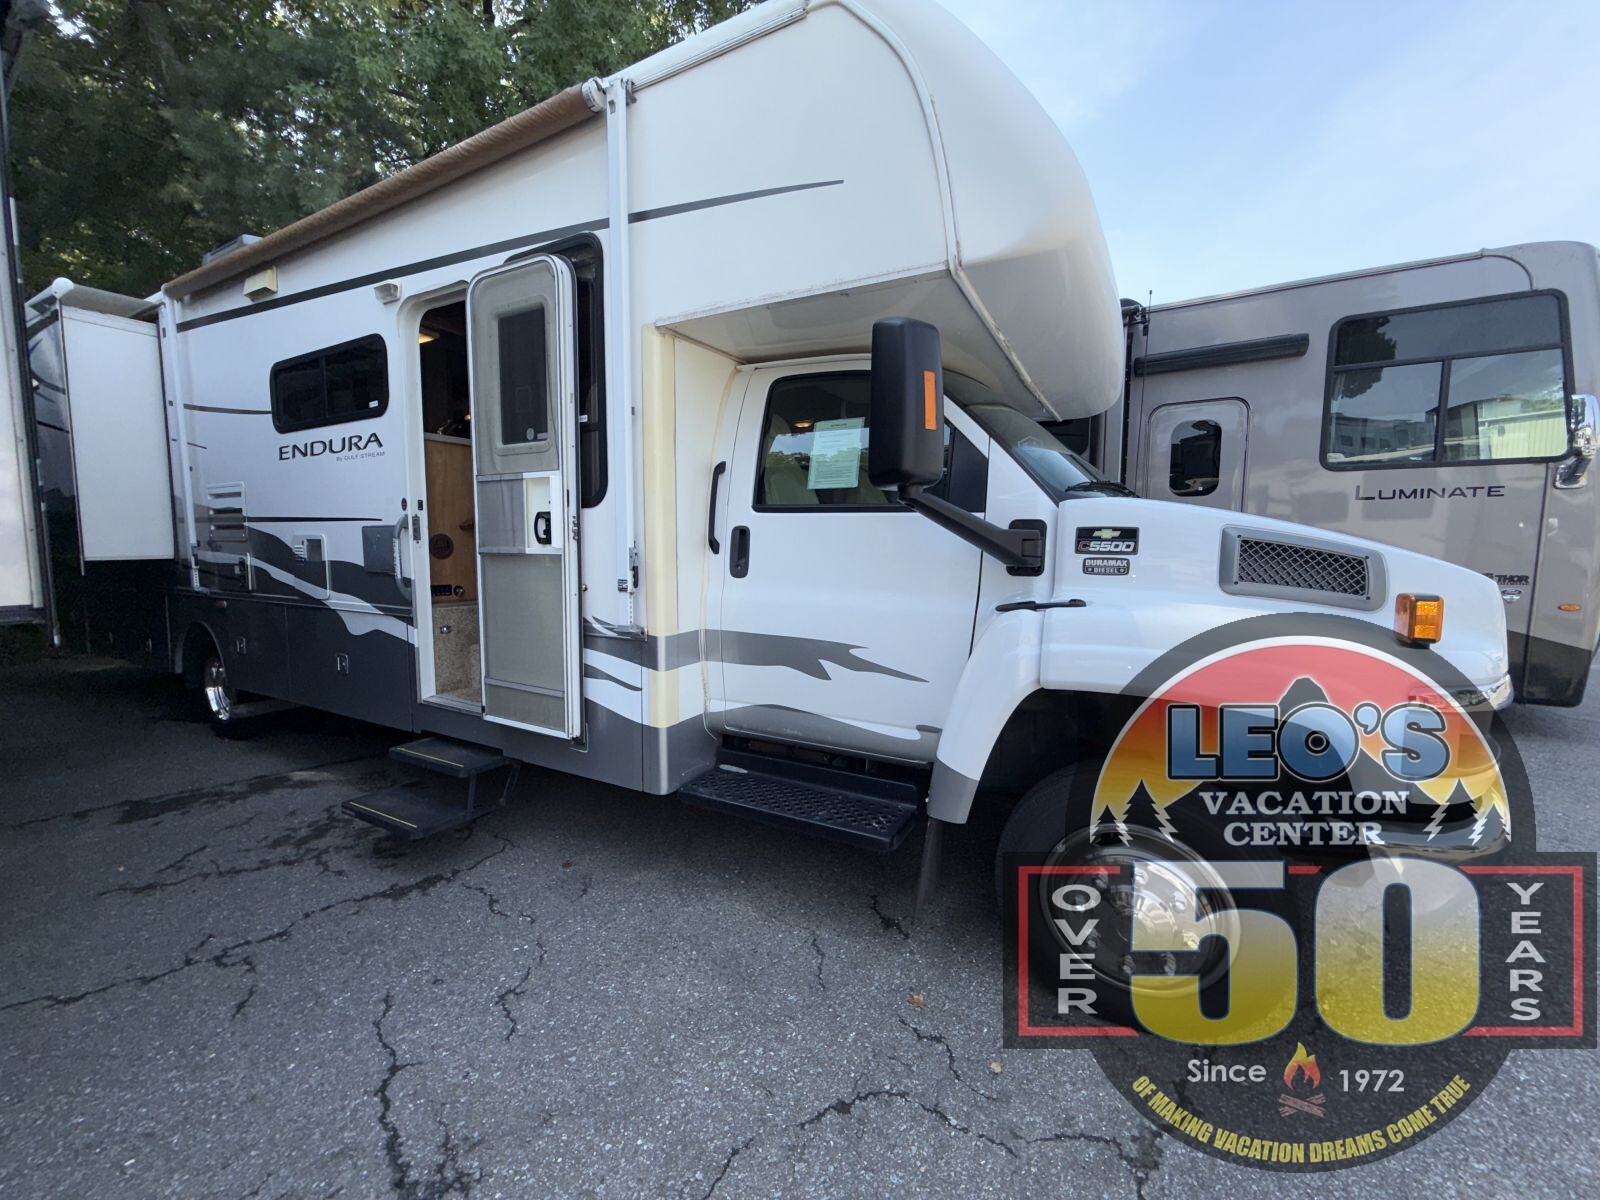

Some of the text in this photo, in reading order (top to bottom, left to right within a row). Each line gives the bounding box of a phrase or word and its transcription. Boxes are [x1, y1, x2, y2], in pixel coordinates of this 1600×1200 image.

[278, 432, 384, 461] ENDURA
[343, 453, 359, 461] GULF
[360, 451, 386, 459] STREAM
[1355, 485, 1506, 501] LUMINATE
[1077, 541, 1136, 552] C5500
[1085, 559, 1128, 567] DURAMAX
[1494, 574, 1530, 583] THOR
